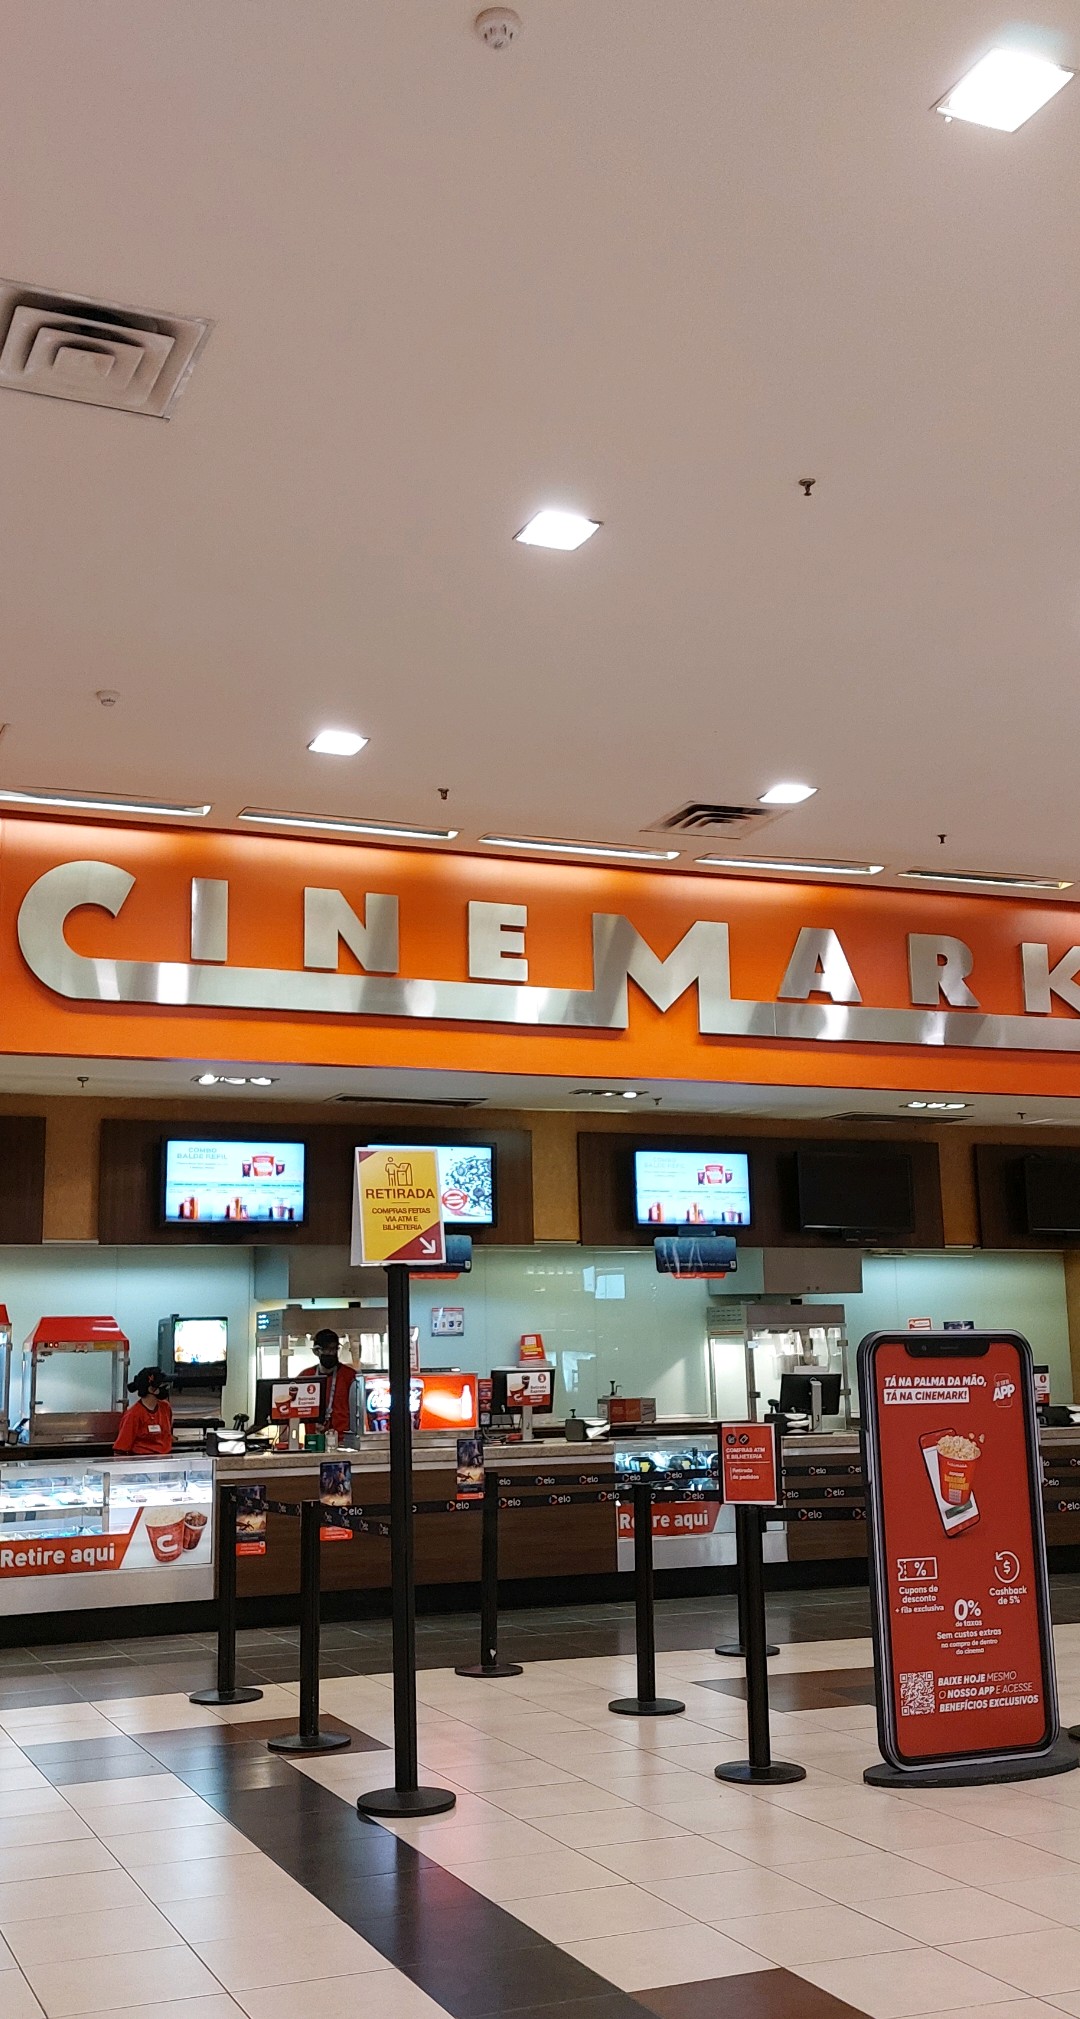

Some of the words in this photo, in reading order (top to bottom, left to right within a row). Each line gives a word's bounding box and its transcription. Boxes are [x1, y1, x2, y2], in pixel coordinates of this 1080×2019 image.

[18, 860, 1080, 1049] CINEMARK
[366, 1188, 435, 1199] RETIRADA
[885, 1375, 896, 1387] TÁ
[898, 1377, 912, 1386] NA
[914, 1376, 945, 1386] PALMA
[947, 1376, 961, 1386] DA
[962, 1374, 987, 1387] MÃO,
[886, 1390, 897, 1401] TÁ
[900, 1392, 913, 1401] NA
[915, 1391, 967, 1401] CINEMARK!
[993, 1384, 1015, 1402] APP
[674, 1510, 708, 1529] aqui
[0, 1547, 65, 1568] Retire
[71, 1543, 115, 1566] aqui
[899, 1587, 928, 1596] Cupons
[928, 1584, 938, 1592] de
[989, 1585, 1027, 1596] Cashback
[902, 1595, 936, 1603] desconto
[998, 1596, 1008, 1605] de
[1009, 1595, 1020, 1604] 5%
[913, 1604, 944, 1612] exclusiva
[954, 1599, 982, 1621] 0%
[937, 1632, 953, 1640] Sem
[954, 1630, 978, 1638] custos
[979, 1628, 1002, 1636] extras
[938, 1676, 962, 1686] BAIXE
[964, 1674, 986, 1684] HOJE
[987, 1671, 1017, 1682] MESMO
[939, 1691, 946, 1699] O
[947, 1688, 977, 1698] NOSSO
[978, 1686, 995, 1696] APP
[996, 1685, 1001, 1694] E
[1002, 1682, 1033, 1693] ACESSE
[939, 1700, 988, 1712] BENEFÍCIOS
[989, 1695, 1039, 1708] EXCLUSIVOS
